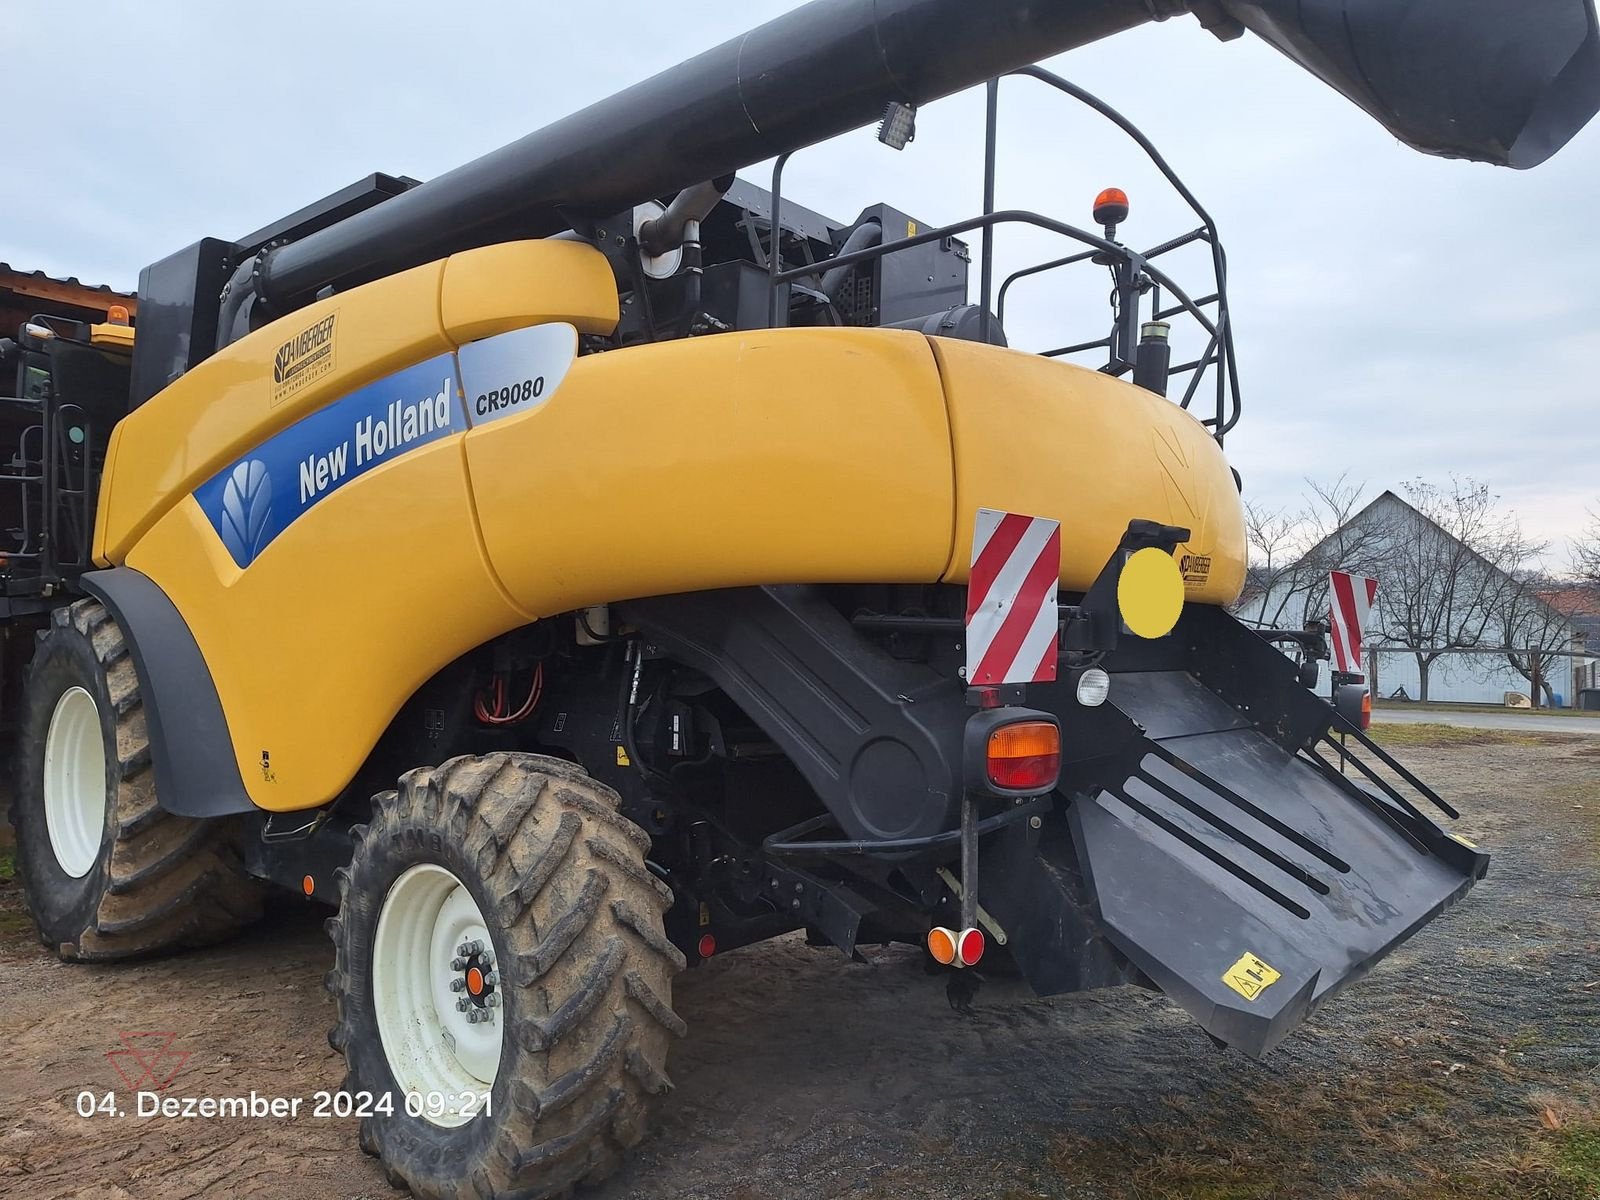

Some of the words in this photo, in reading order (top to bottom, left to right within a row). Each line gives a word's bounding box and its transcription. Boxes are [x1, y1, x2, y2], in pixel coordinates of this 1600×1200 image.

[280, 314, 335, 369] PAMBERGER
[475, 375, 545, 416] CR9080
[298, 441, 348, 504] New
[355, 377, 452, 466] Holland
